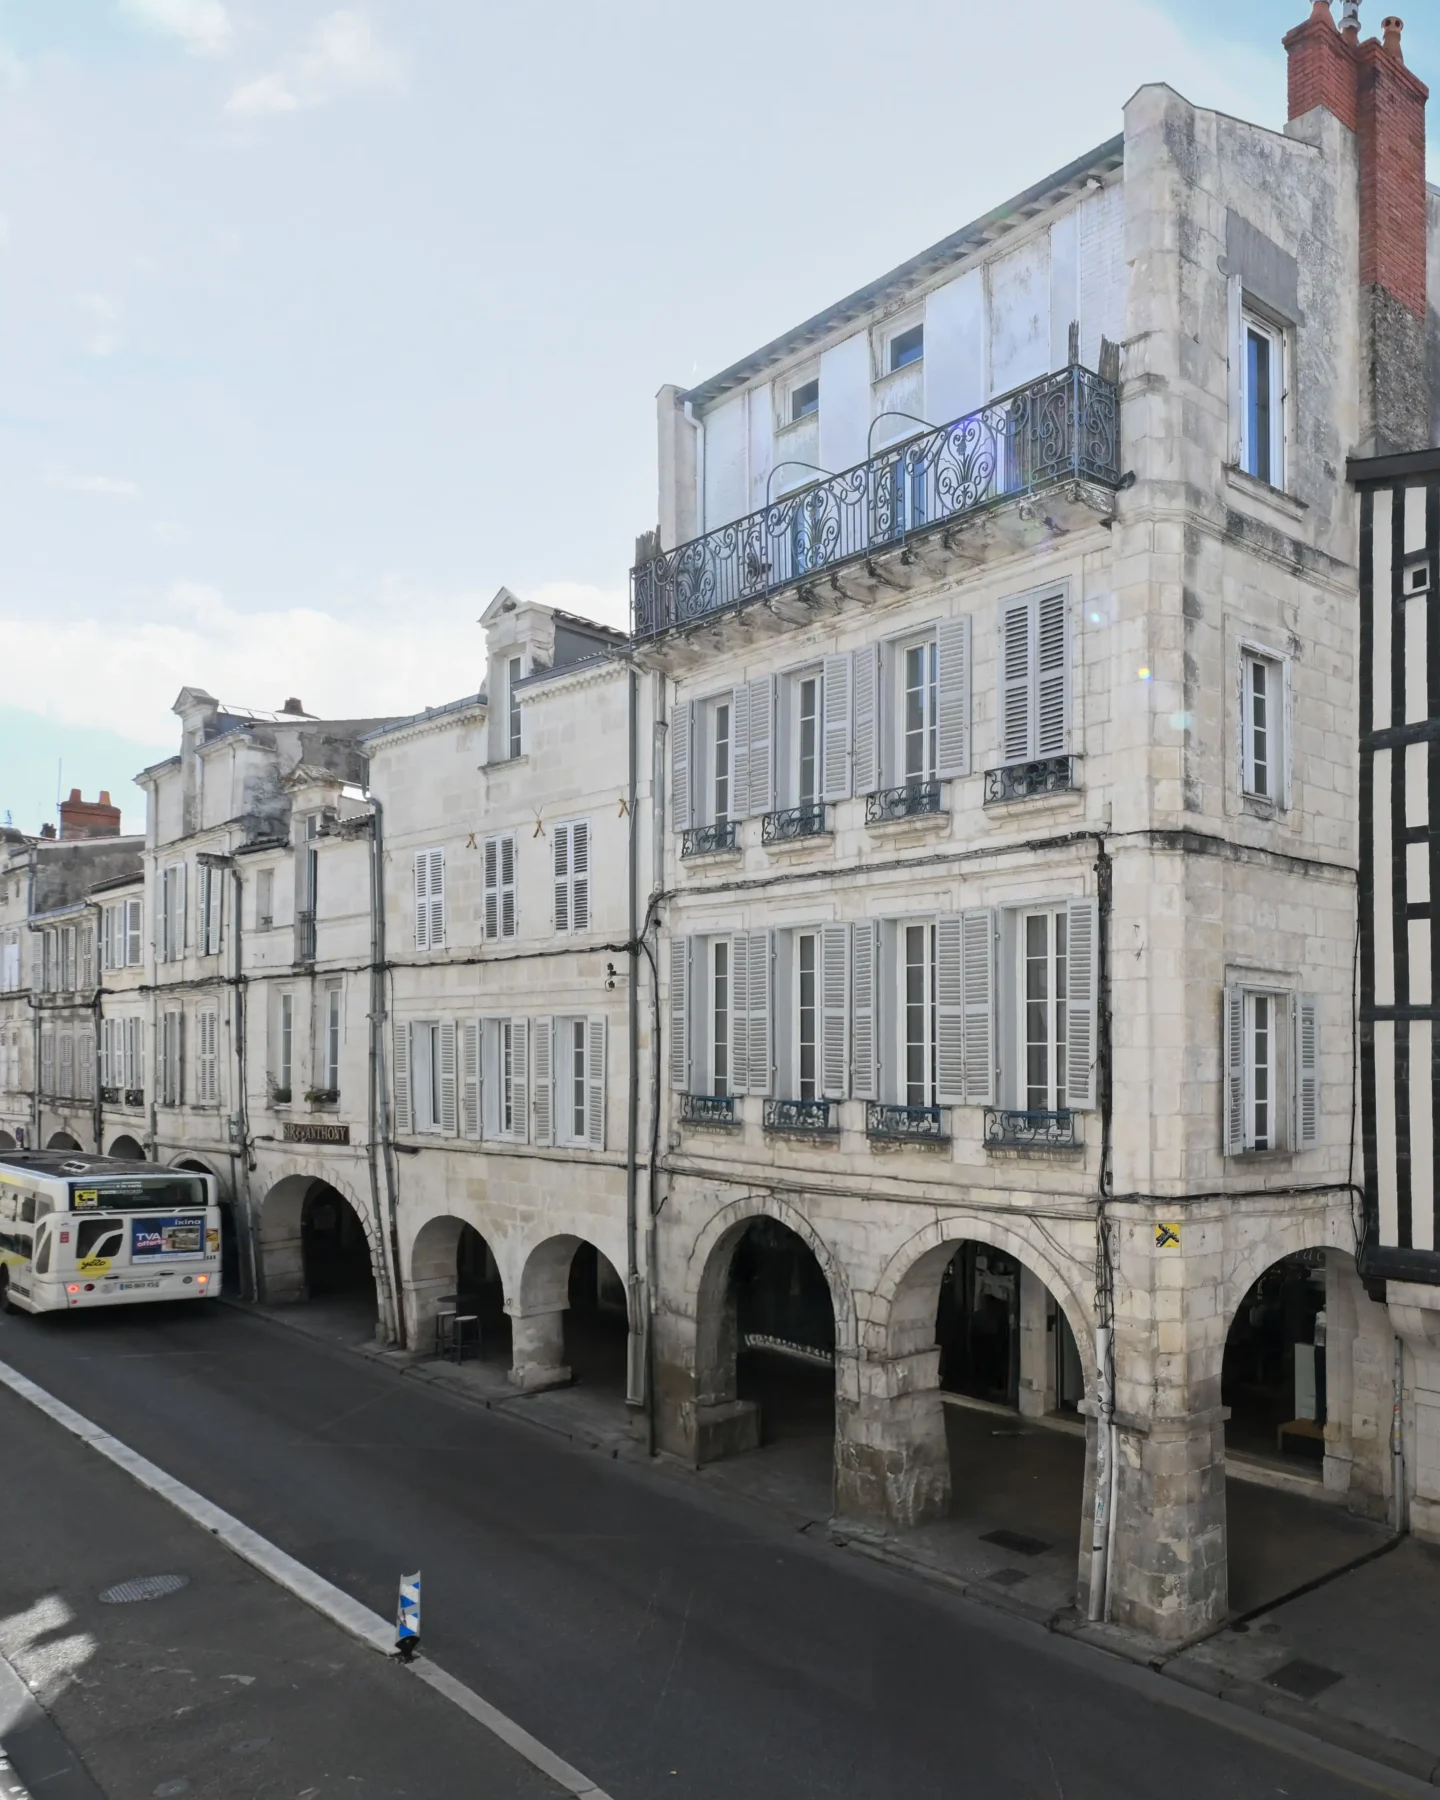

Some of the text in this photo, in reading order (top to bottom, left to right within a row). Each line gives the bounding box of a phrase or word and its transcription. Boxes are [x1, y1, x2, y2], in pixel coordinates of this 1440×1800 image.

[306, 1126, 346, 1141] ANTHONY
[136, 1233, 161, 1241] TVA
[137, 1239, 167, 1247] offerte
